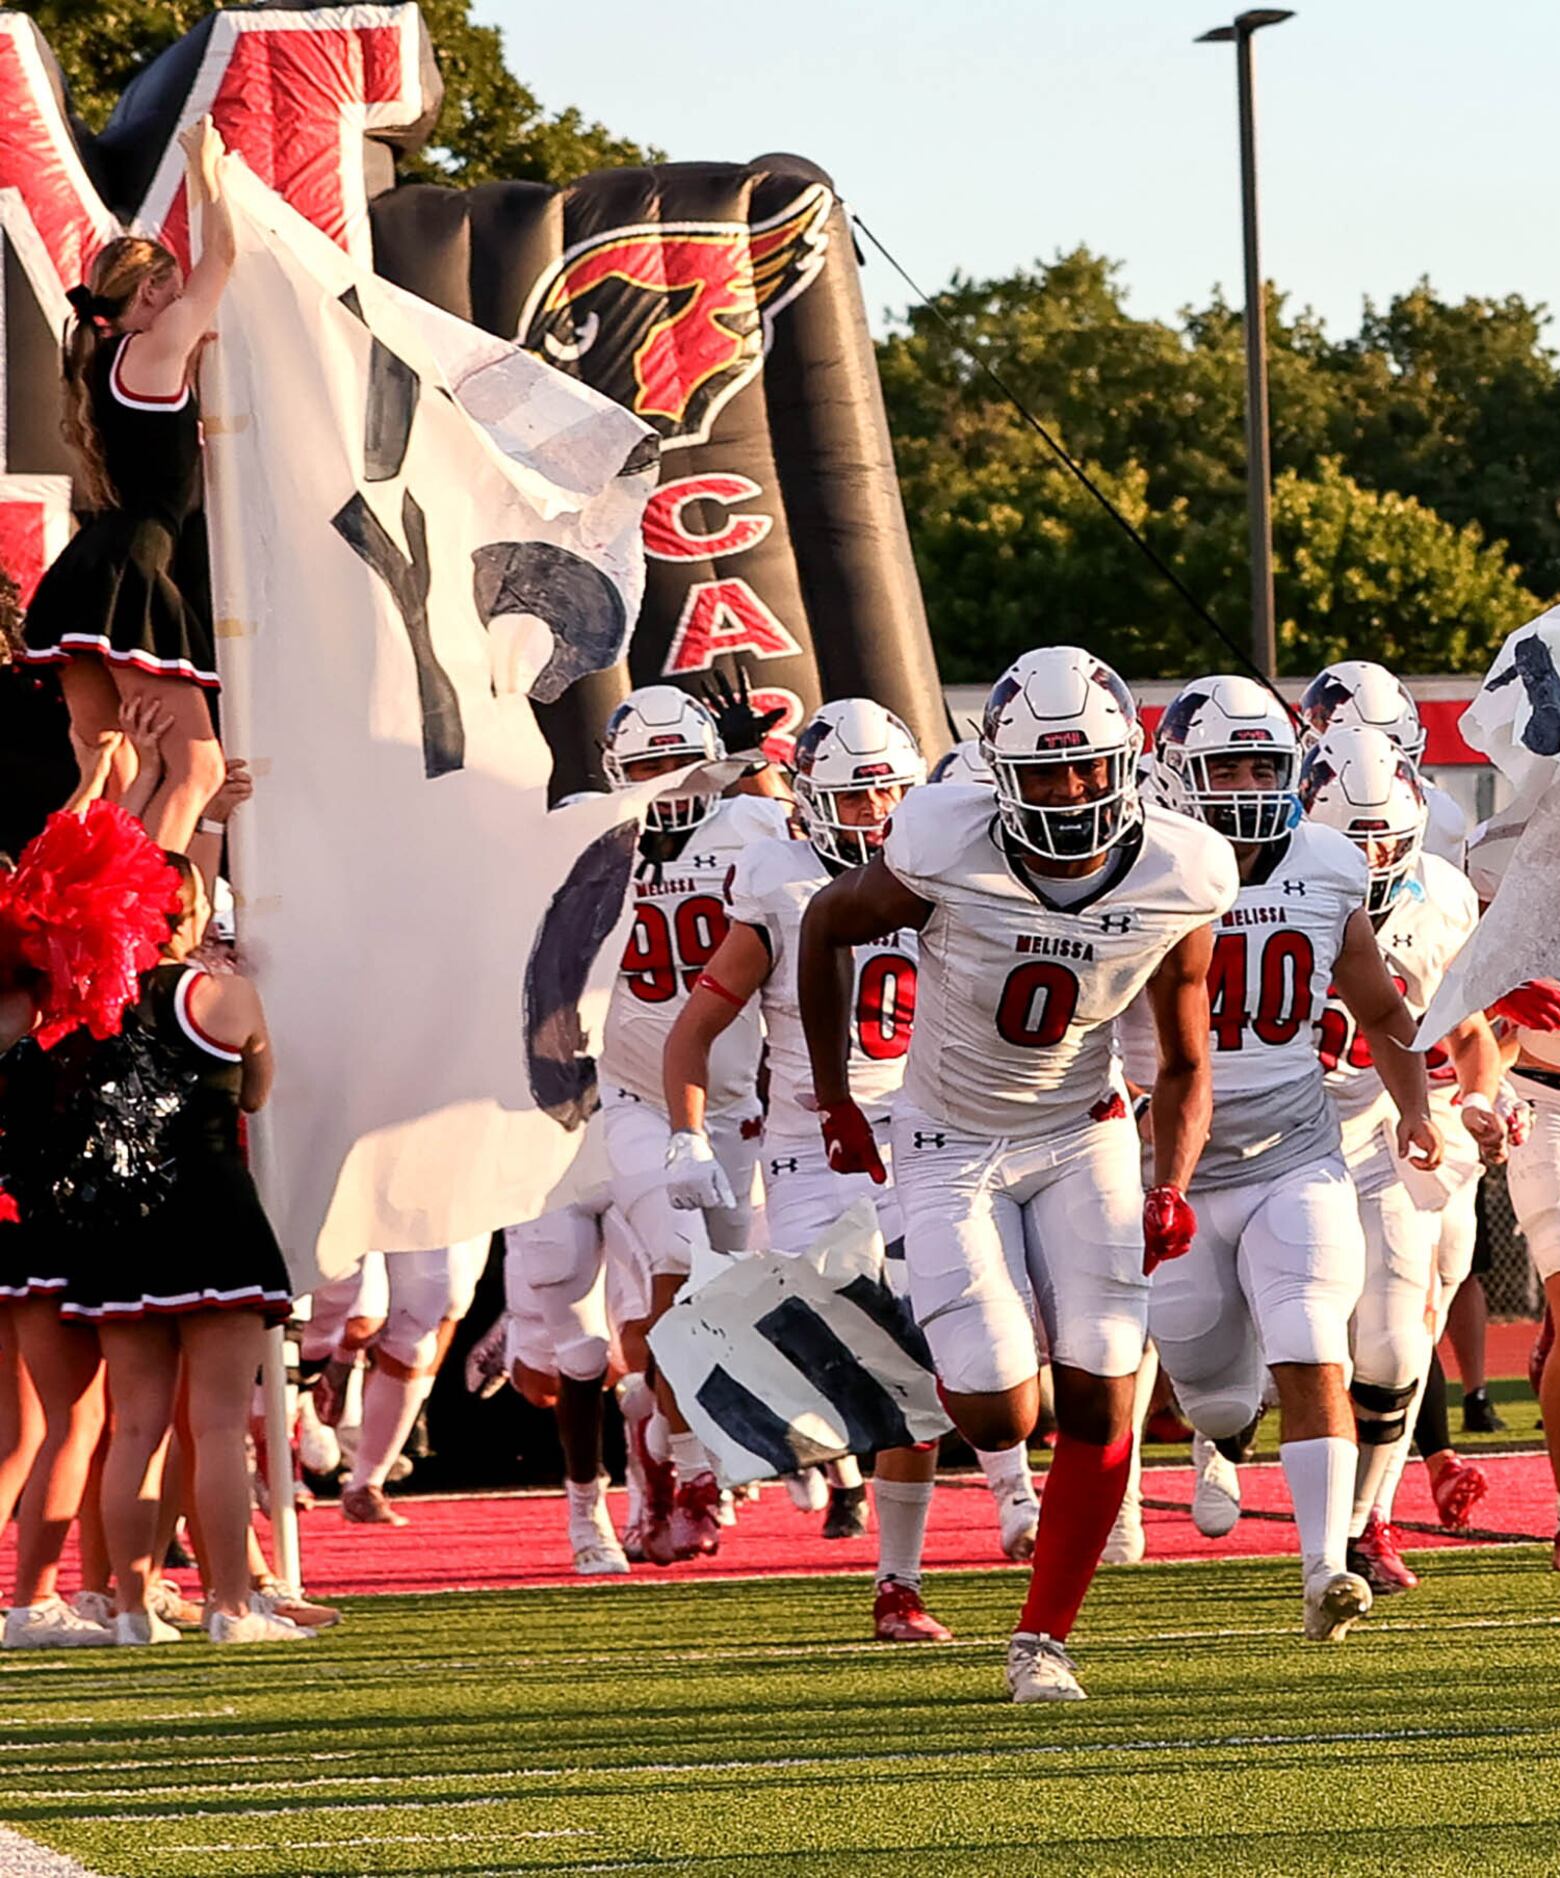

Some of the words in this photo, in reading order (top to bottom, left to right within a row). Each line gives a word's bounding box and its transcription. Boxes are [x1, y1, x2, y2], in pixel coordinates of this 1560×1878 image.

[636, 878, 697, 898] MELISSA
[1221, 906, 1287, 928] MELISSA
[620, 895, 731, 1003] 99
[1016, 934, 1095, 962] MELISSA
[996, 960, 1080, 1048] 0
[1206, 928, 1315, 1051] 40
